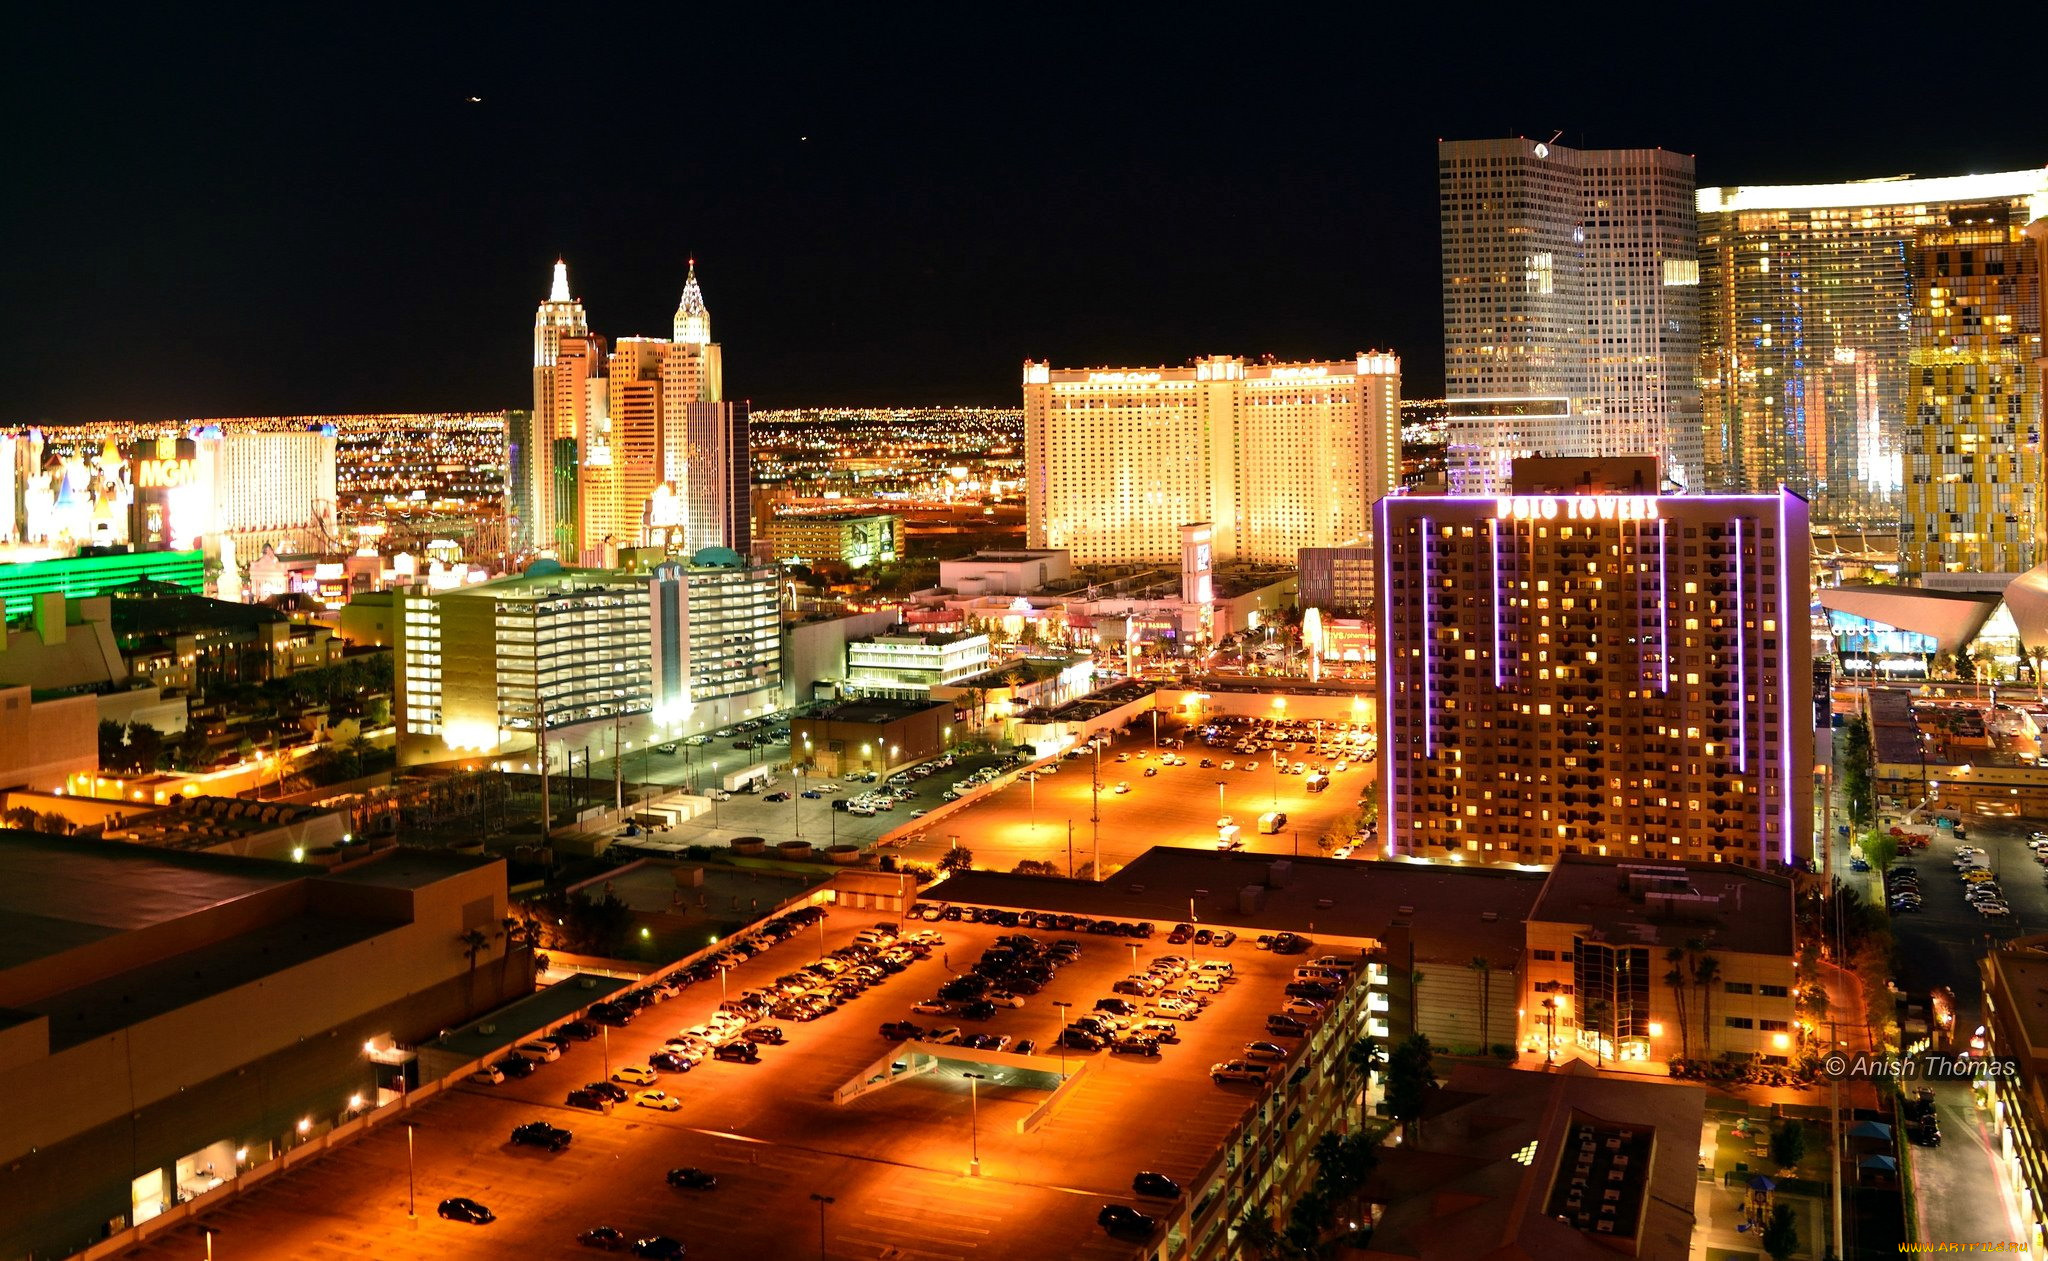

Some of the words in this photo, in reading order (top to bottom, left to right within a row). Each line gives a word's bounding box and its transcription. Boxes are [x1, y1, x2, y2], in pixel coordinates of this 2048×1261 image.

[139, 459, 200, 487] MGM
[1497, 497, 1558, 519] POLO
[1567, 497, 1659, 519] TOWERS
